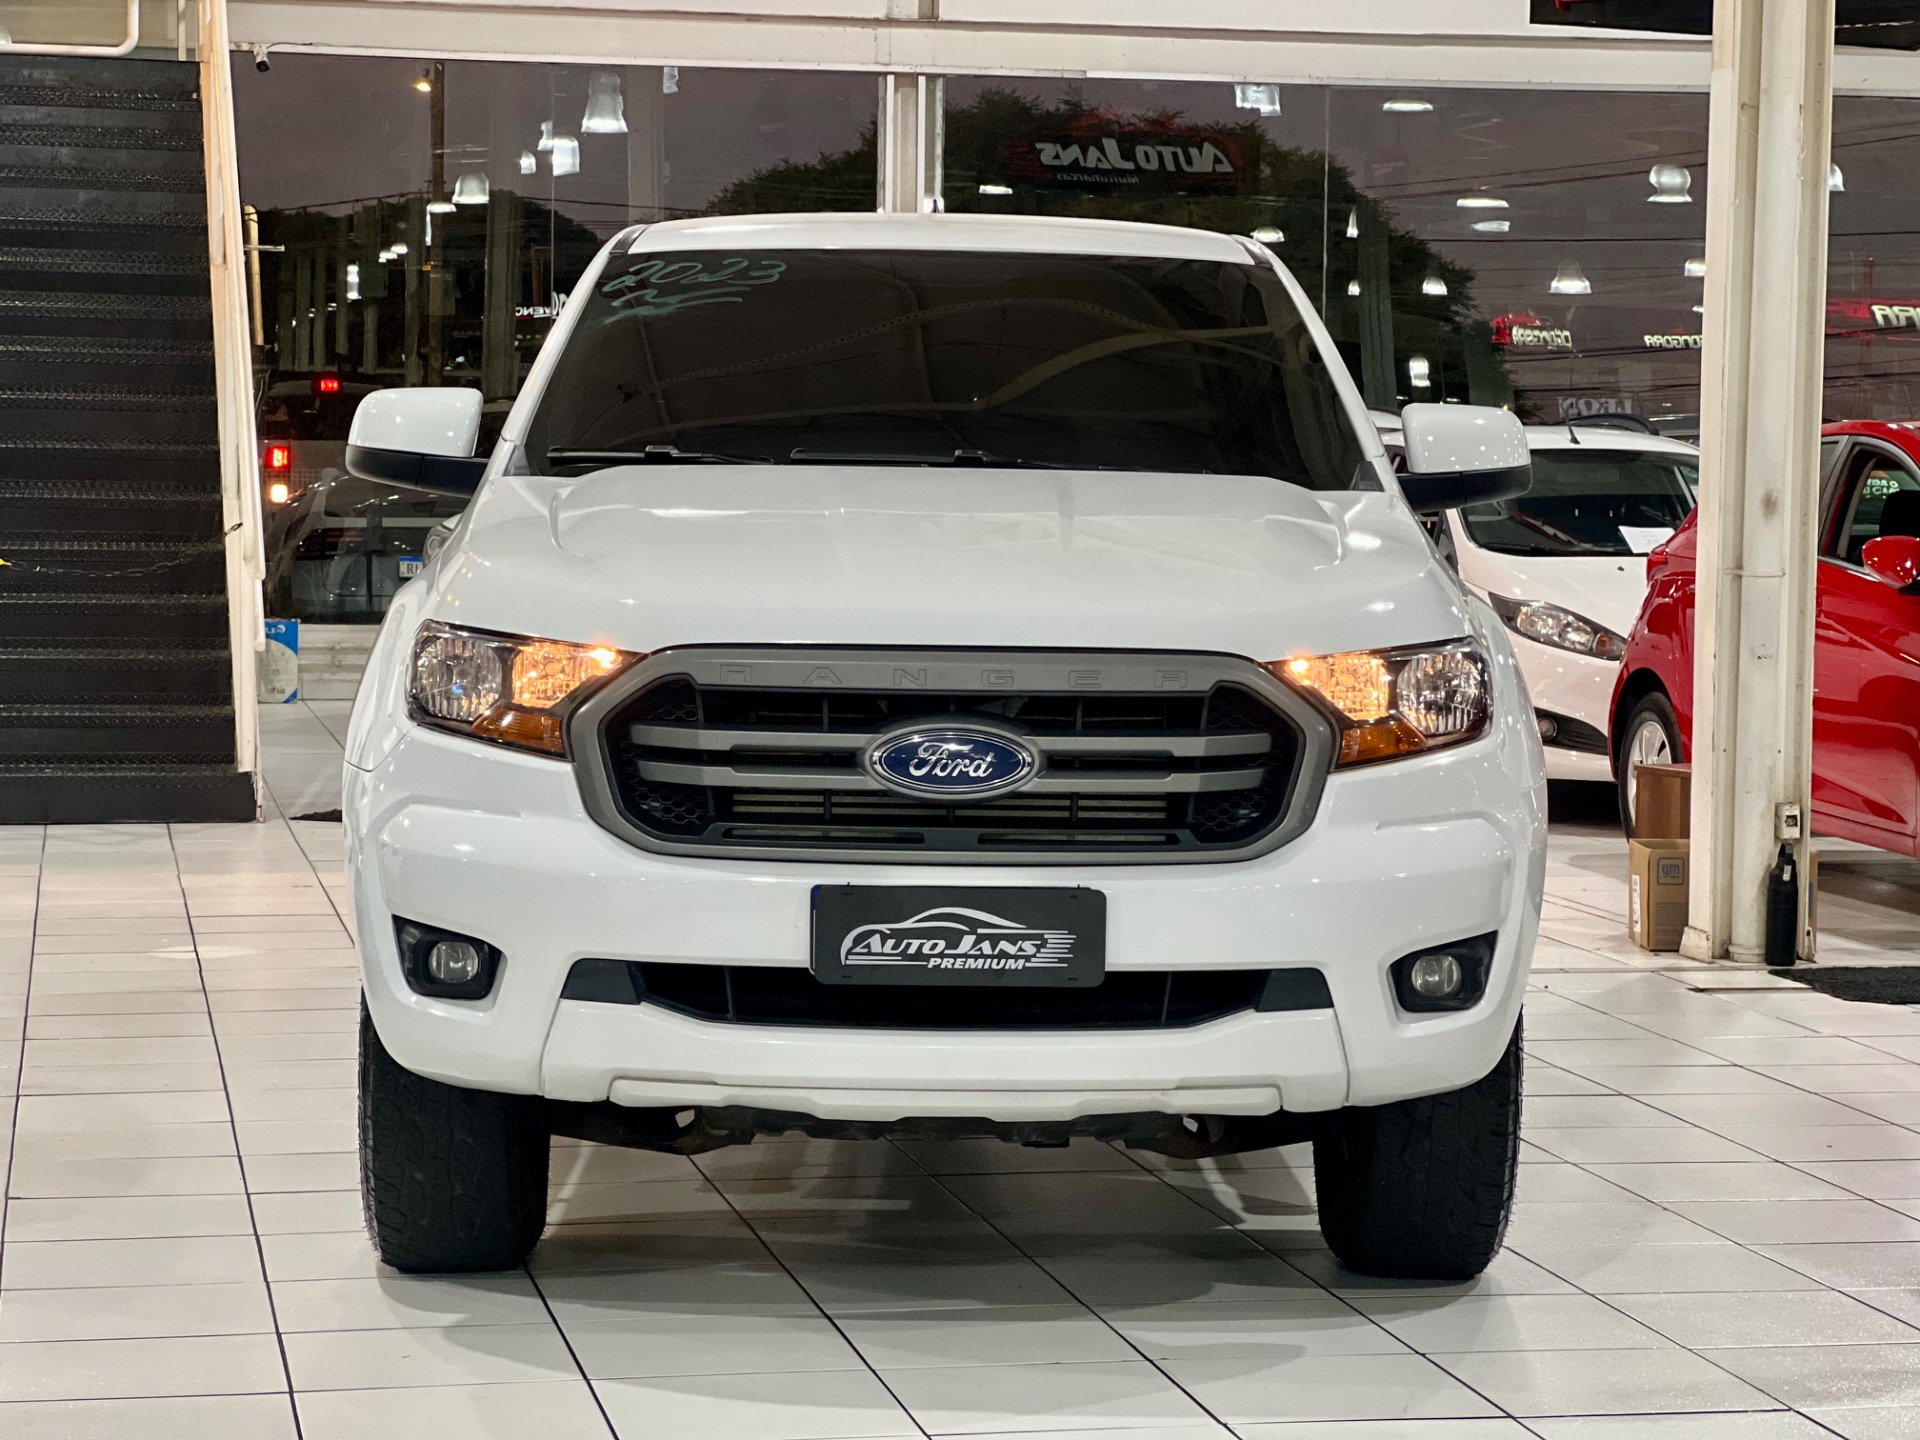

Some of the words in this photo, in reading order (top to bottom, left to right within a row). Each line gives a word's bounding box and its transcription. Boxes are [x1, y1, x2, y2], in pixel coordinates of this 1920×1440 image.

[602, 258, 787, 292] 2023
[720, 664, 1187, 689] RANGER
[909, 742, 994, 778] Ford
[1661, 863, 1680, 879] gm
[927, 957, 1027, 970] PREMIUM
